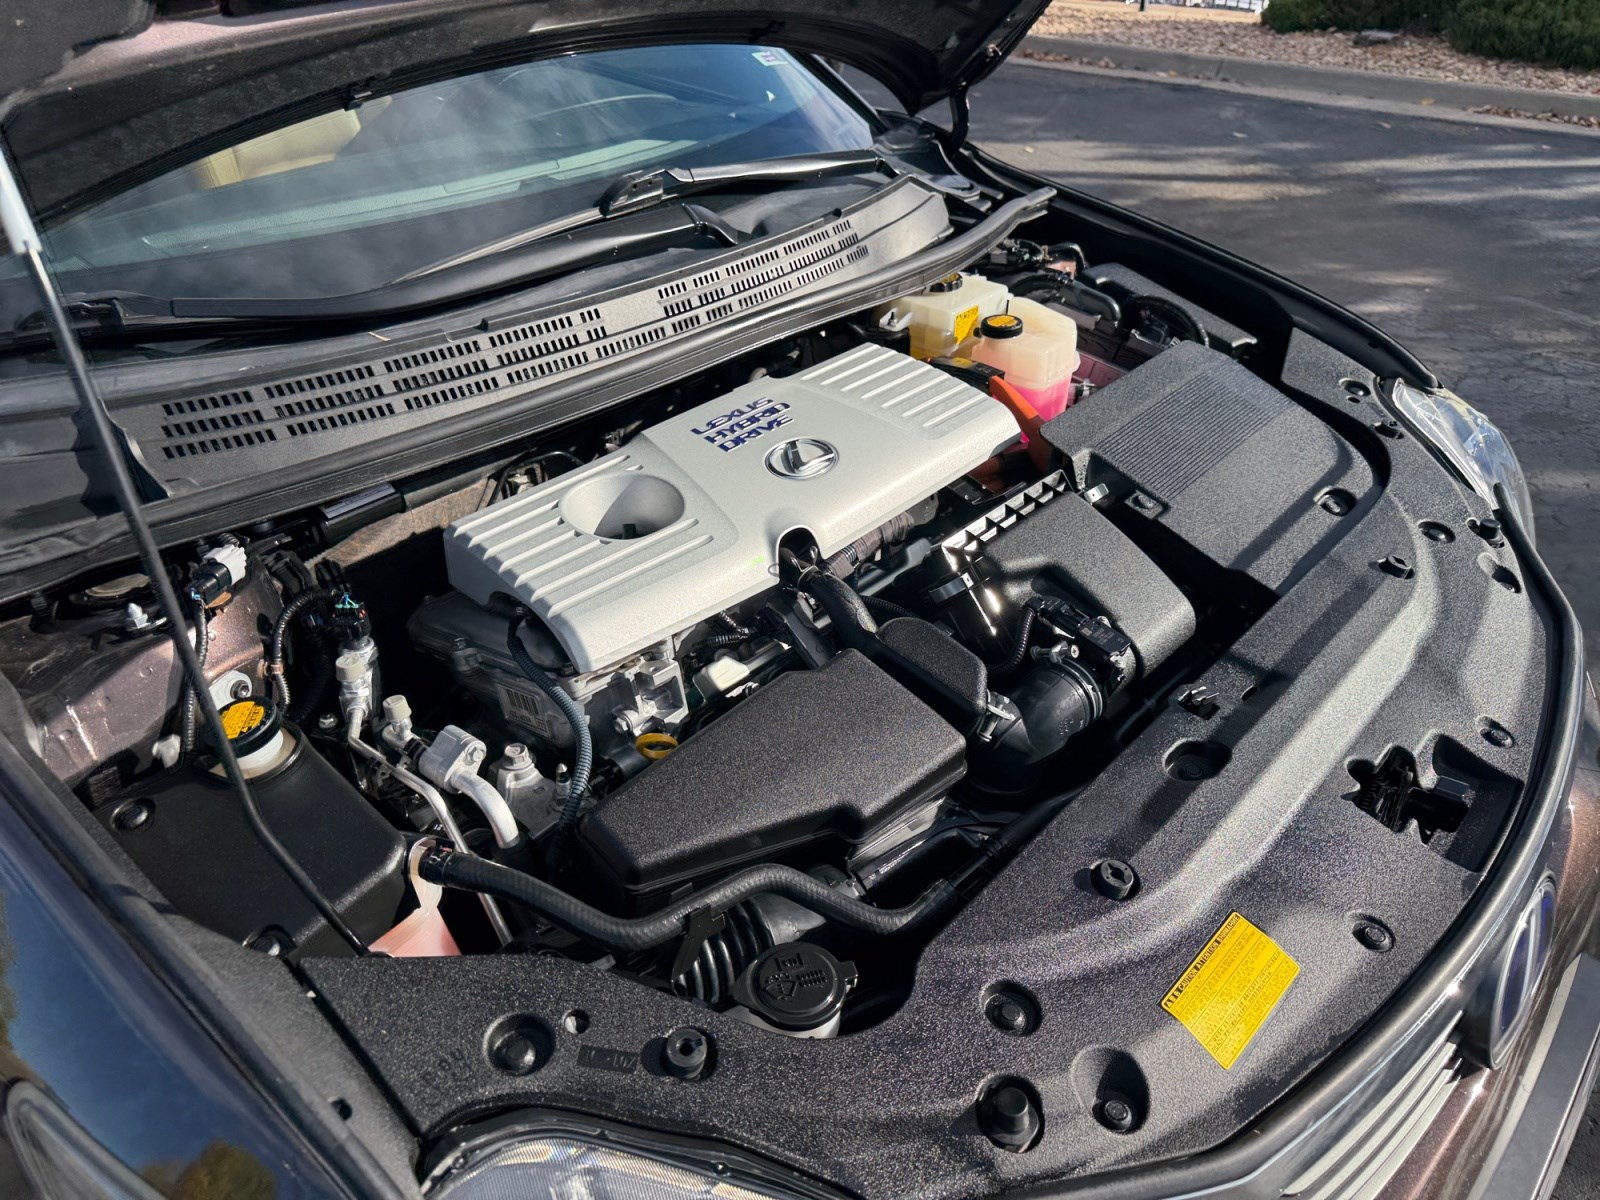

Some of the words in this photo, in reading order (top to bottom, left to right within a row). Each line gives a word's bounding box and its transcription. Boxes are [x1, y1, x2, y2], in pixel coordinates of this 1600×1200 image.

[690, 397, 773, 435] LEXUS
[704, 402, 791, 444] HYBRID
[717, 414, 794, 453] DRIVE
[1177, 966, 1198, 991] CAUTION
[1194, 940, 1219, 969] ATTENTION
